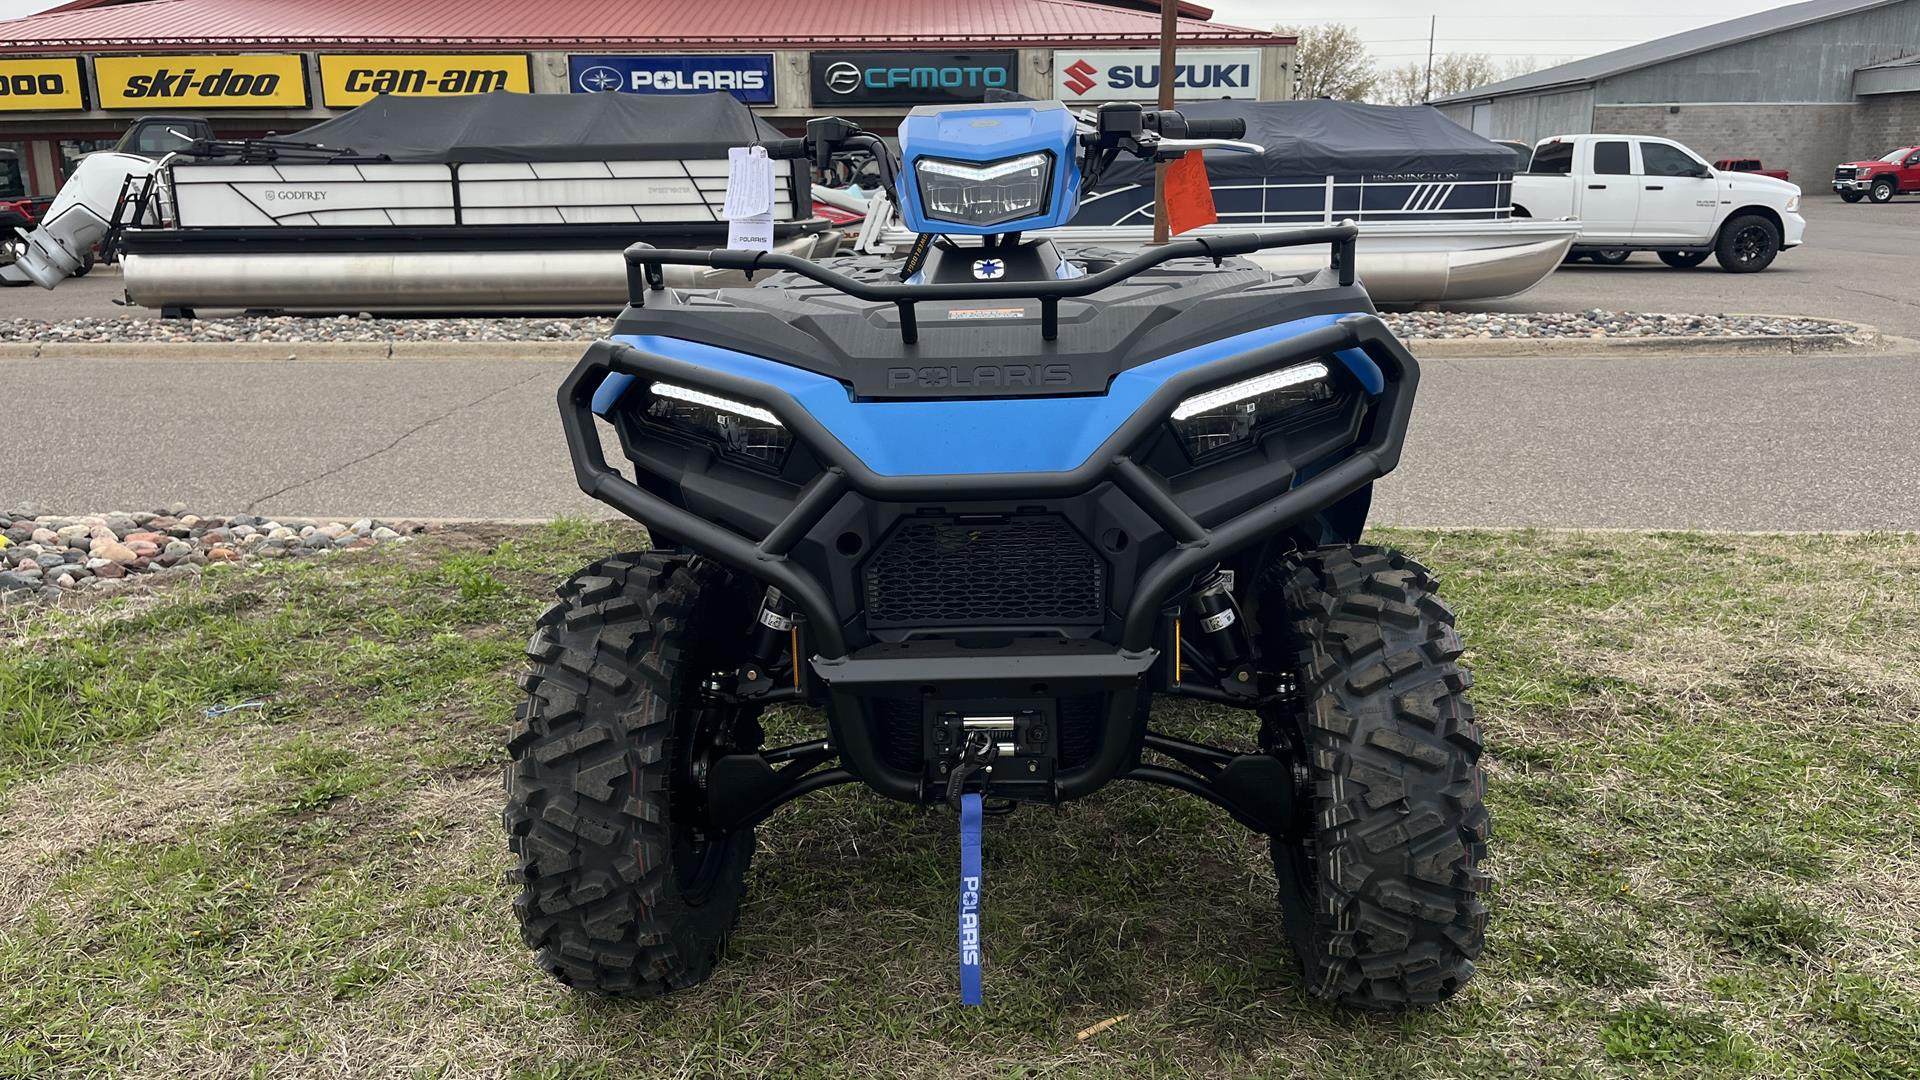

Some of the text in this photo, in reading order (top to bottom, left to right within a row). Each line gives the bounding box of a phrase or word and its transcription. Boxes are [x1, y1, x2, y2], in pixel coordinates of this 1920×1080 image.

[123, 68, 280, 98] ski-doo
[345, 69, 508, 94] can-am
[631, 70, 765, 90] POLARIS
[864, 66, 1007, 89] CFMOTO
[278, 191, 327, 201] GODFREY
[908, 233, 928, 273] OWERLODGE
[888, 364, 1072, 389] POLARIS
[962, 876, 979, 966] POLARIS
